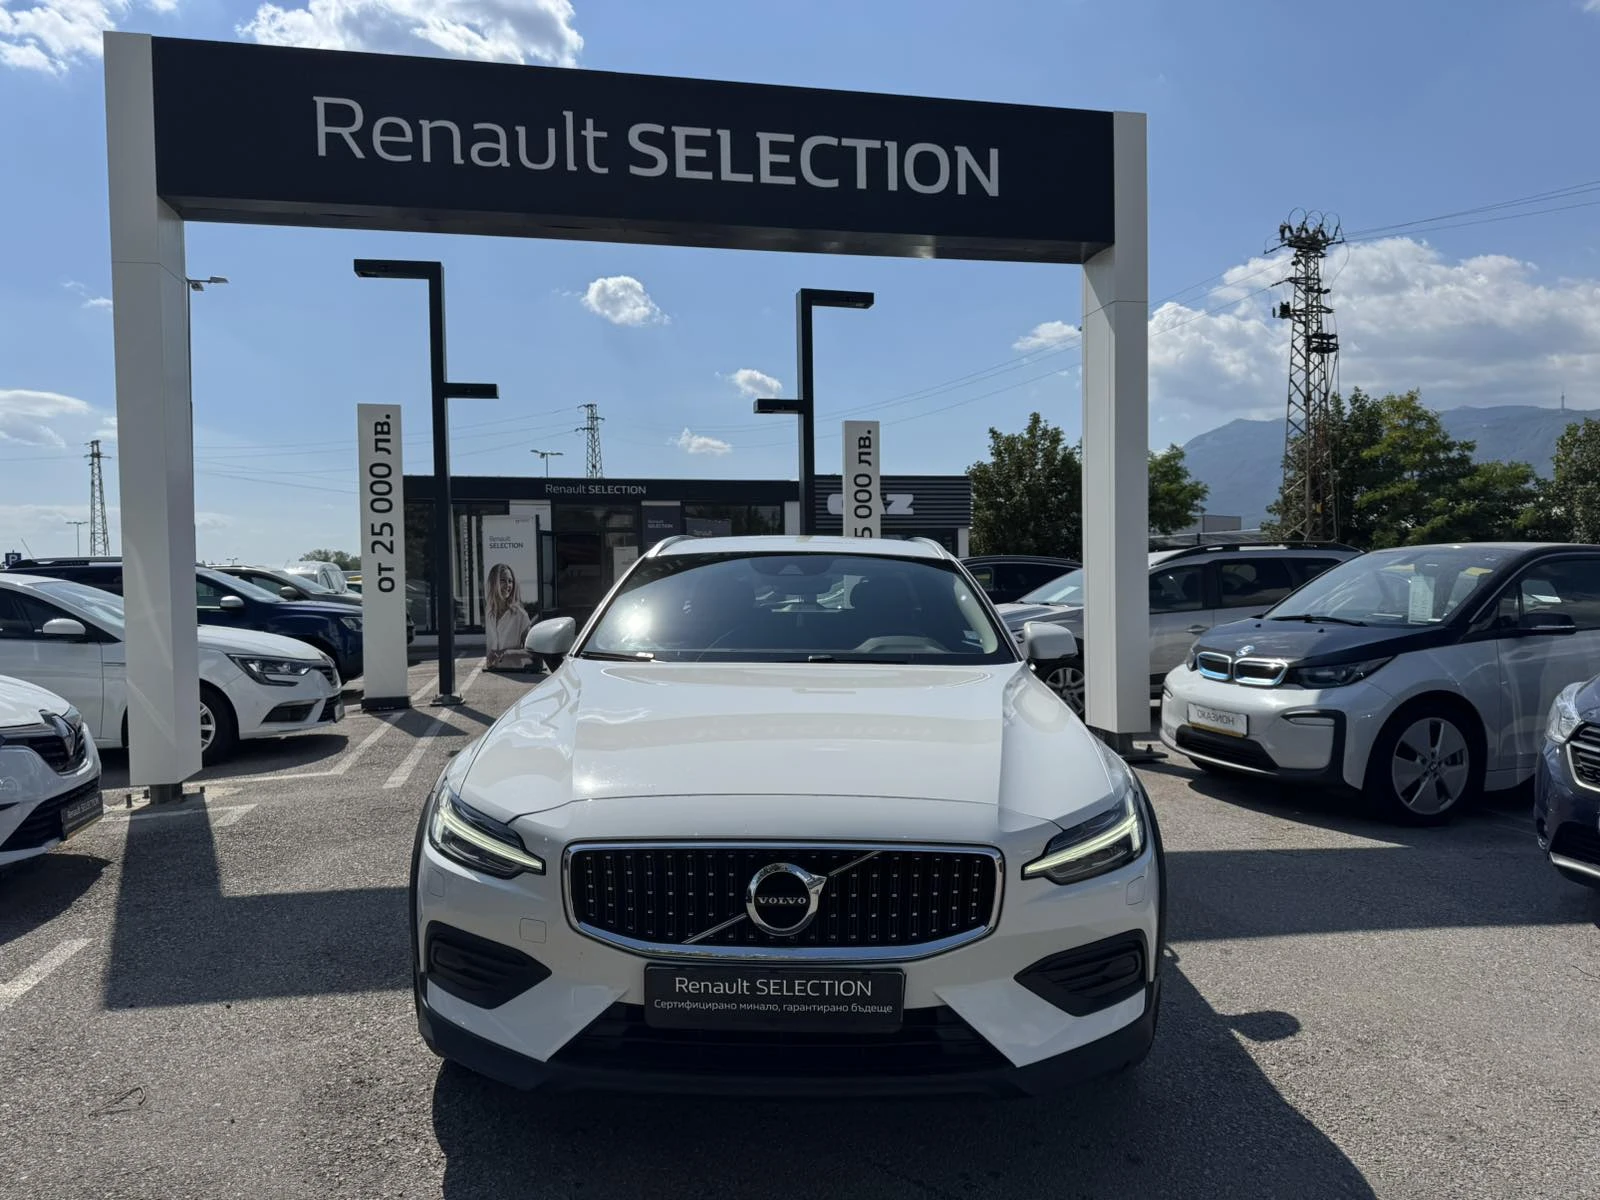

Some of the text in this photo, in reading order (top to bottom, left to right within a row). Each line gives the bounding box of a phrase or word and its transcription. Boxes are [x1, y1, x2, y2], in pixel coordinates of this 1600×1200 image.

[313, 96, 1000, 198] Renault SELECTION
[858, 429, 872, 467] лв.
[545, 483, 647, 495] Renault SELECTION
[853, 473, 872, 519] 000
[369, 413, 396, 593] от 25 000 лв.
[9, 554, 18, 566] P
[758, 896, 806, 904] VOLVO
[675, 977, 872, 997] Renault SELECTION
[654, 999, 893, 1013] Сертифицирано минало, гарантирано бъдеще
